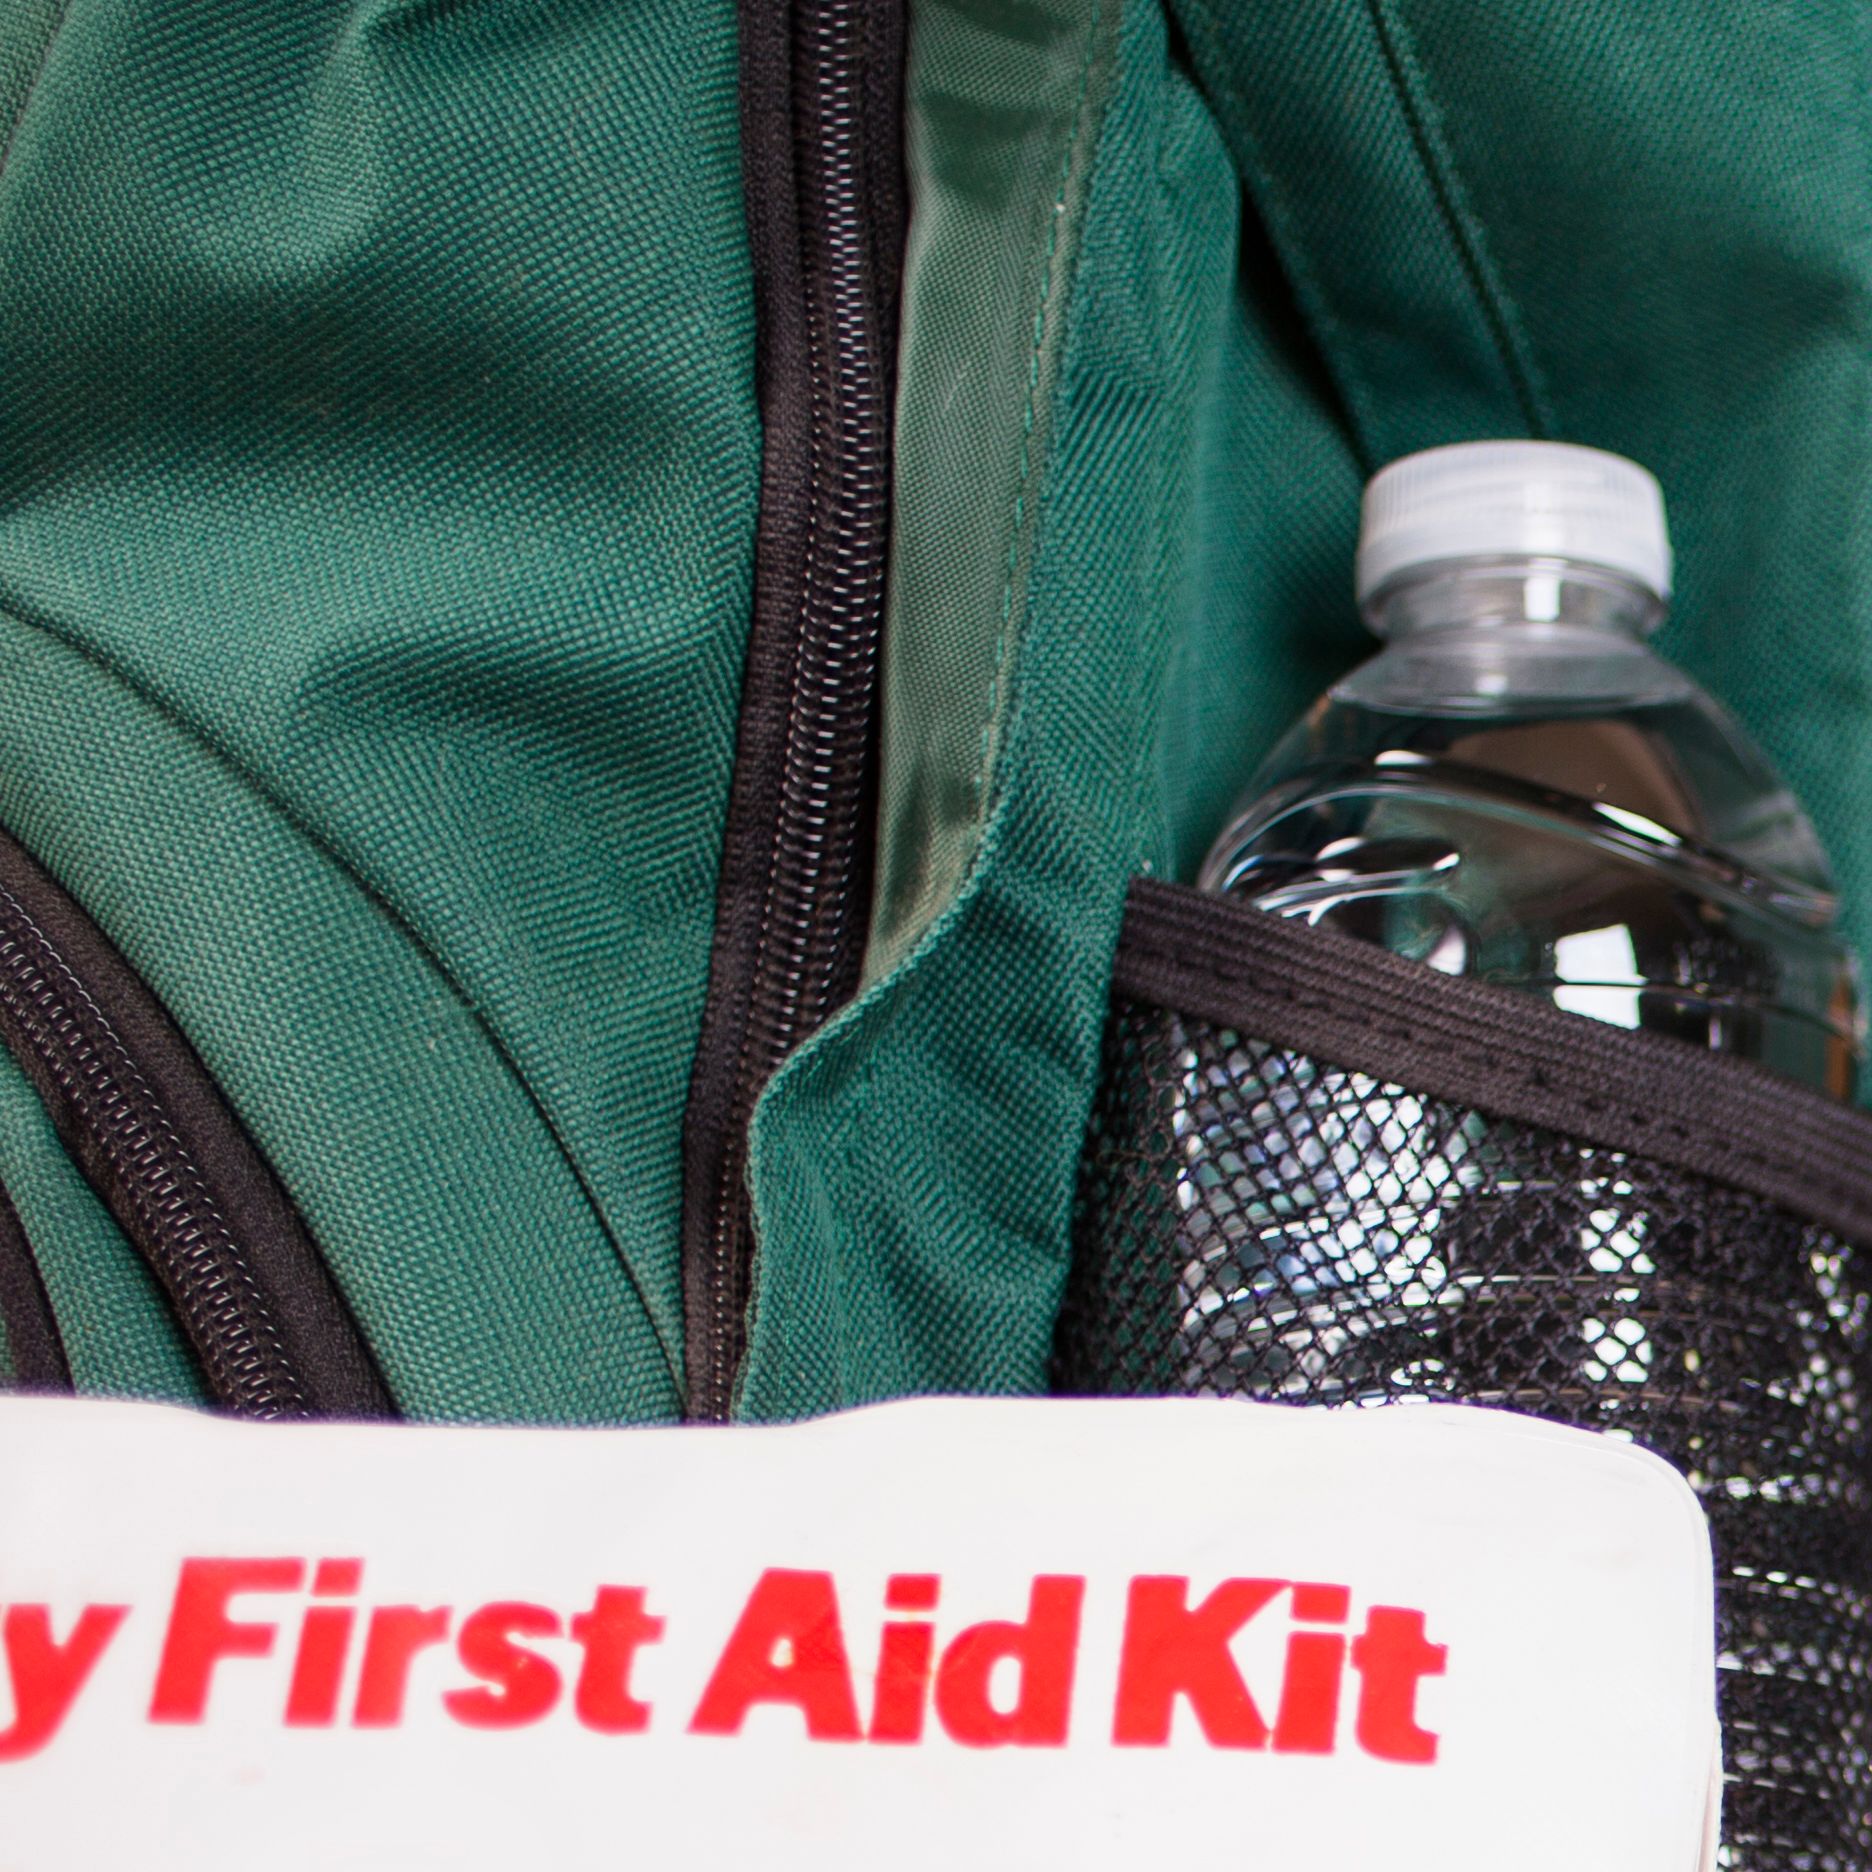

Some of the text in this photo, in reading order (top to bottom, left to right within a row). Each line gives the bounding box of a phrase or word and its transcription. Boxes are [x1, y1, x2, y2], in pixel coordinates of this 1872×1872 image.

[144, 1554, 669, 1738] First
[683, 1565, 1089, 1751] Aid
[1109, 1571, 1452, 1769] Kit
